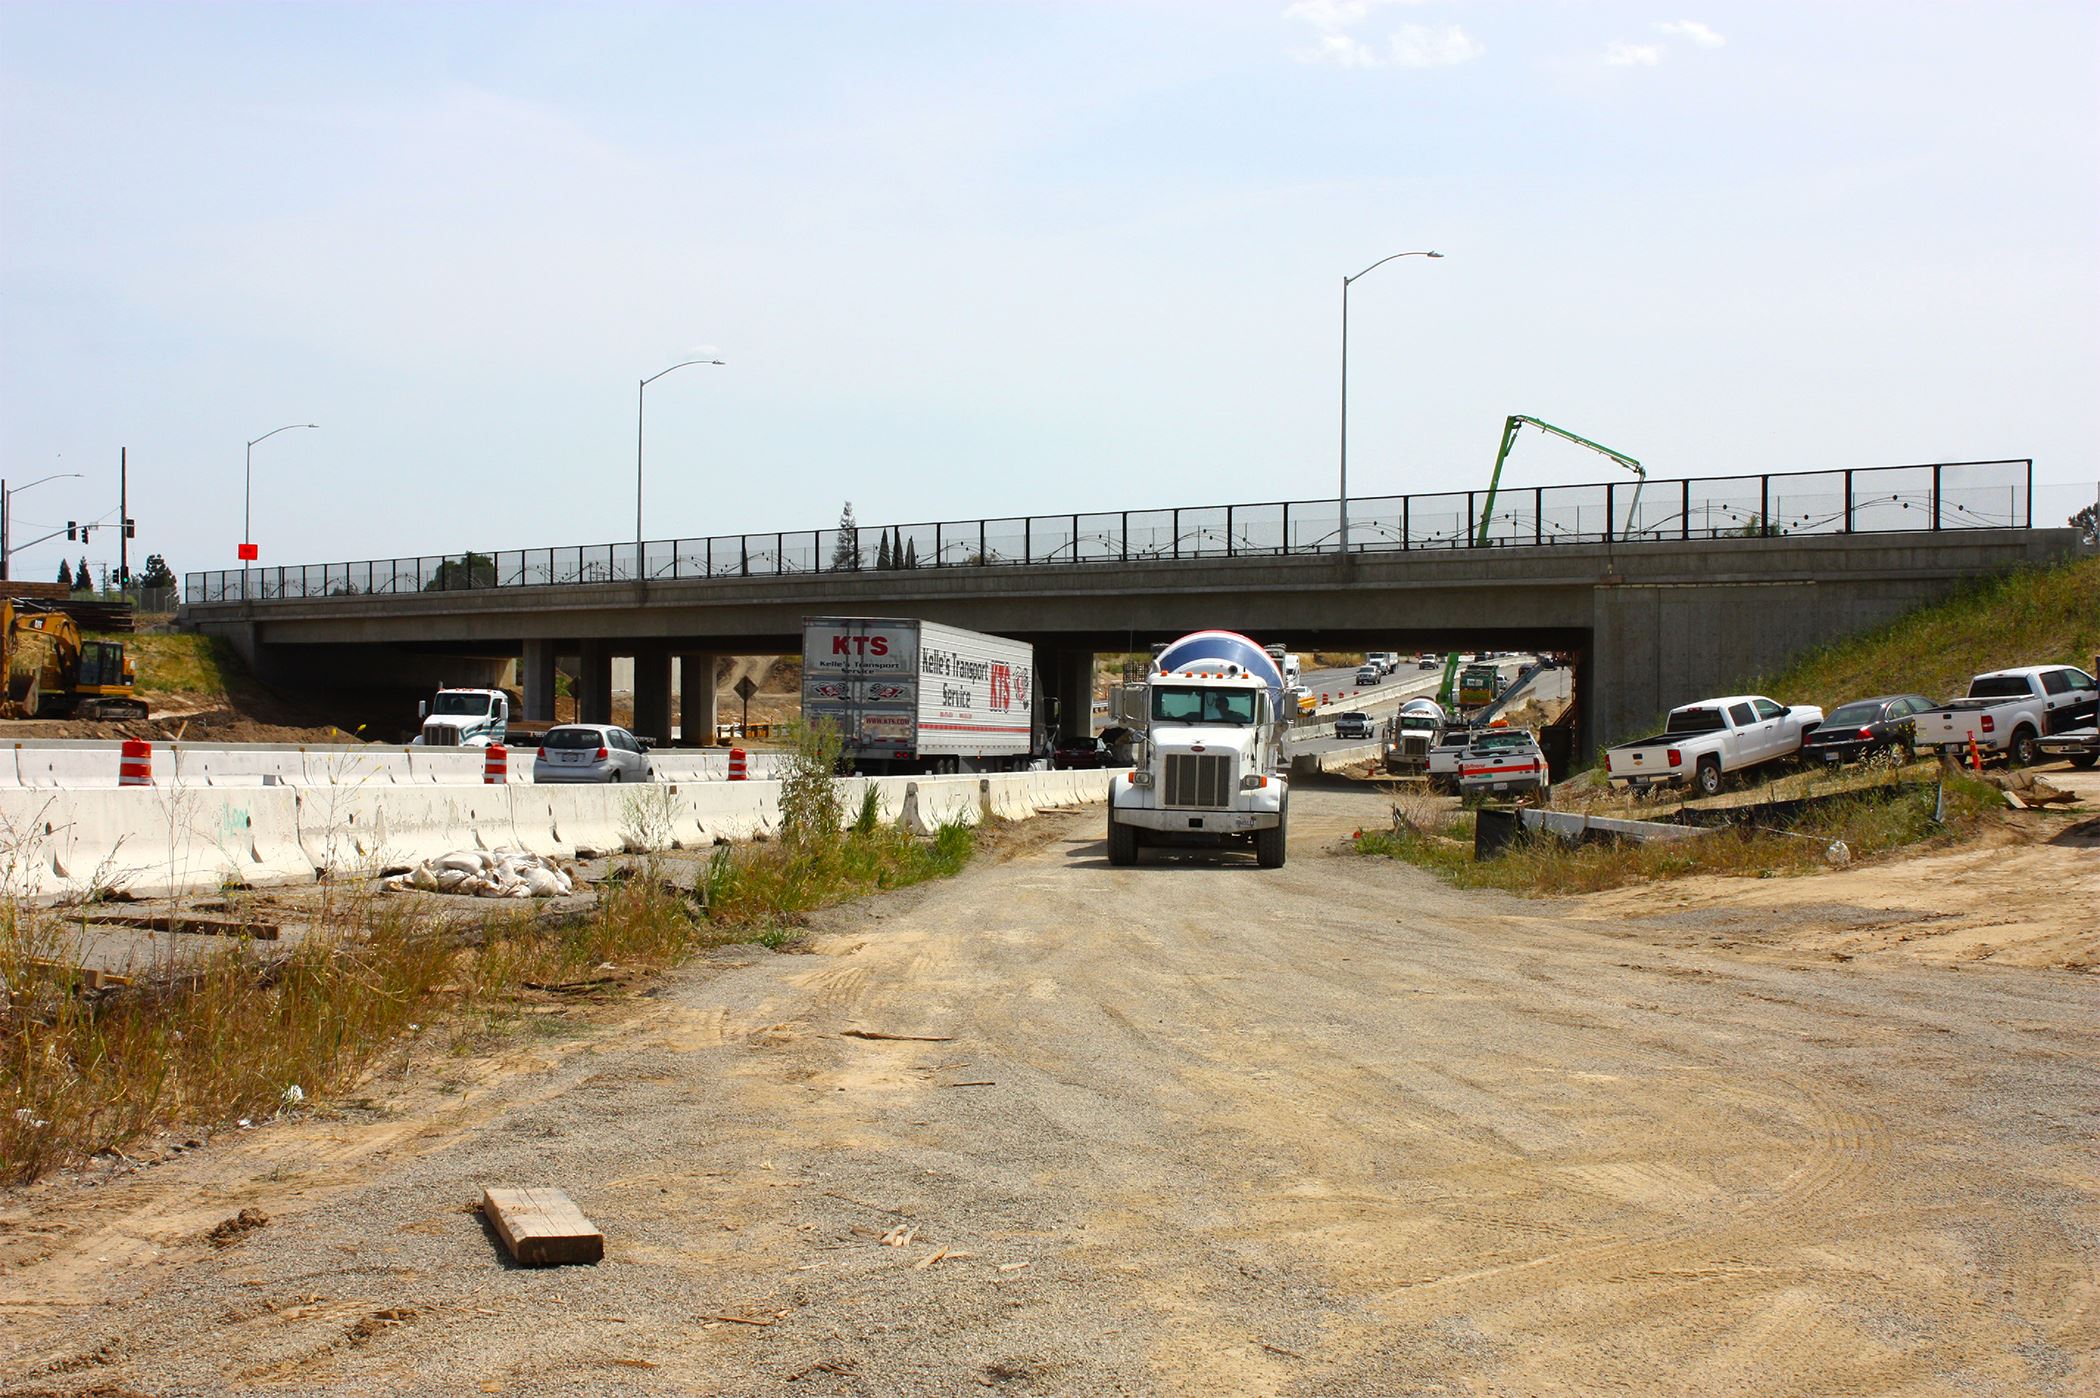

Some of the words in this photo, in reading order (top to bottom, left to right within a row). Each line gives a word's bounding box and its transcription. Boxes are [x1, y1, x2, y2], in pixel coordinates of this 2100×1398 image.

[832, 635, 889, 656] KTS
[819, 660, 850, 669] Kelle's
[855, 661, 900, 670] Transport
[922, 647, 951, 676] Kelle's
[952, 652, 989, 685] Transport
[943, 683, 970, 708] Service
[989, 659, 1011, 714] KTS
